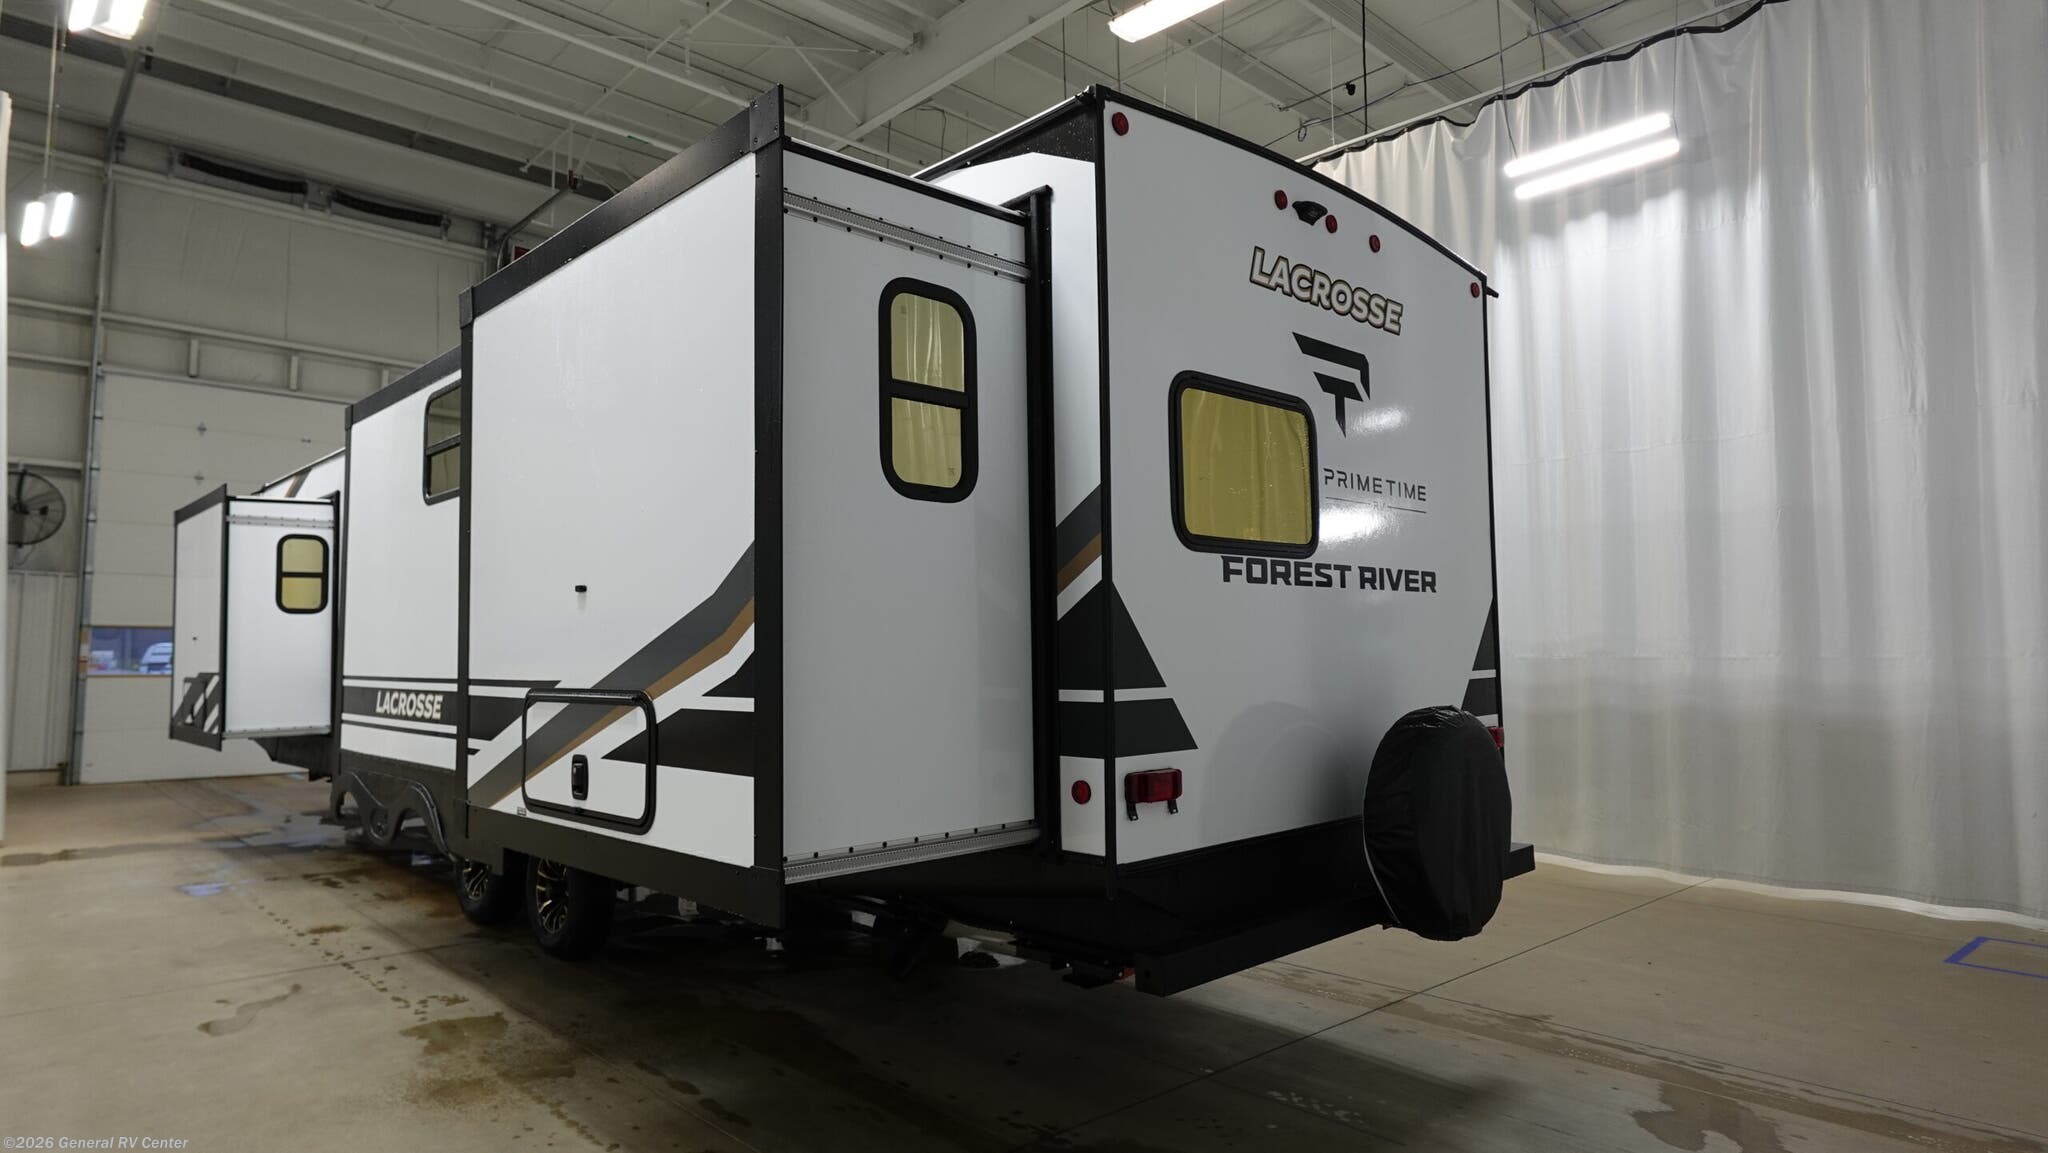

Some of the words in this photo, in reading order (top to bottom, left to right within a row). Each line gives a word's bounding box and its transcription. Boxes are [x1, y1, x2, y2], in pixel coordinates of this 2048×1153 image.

[1250, 246, 1403, 335] LACROSSE
[1220, 555, 1352, 589] FOREST
[1358, 566, 1437, 593] RIVER
[376, 691, 442, 720] LACROSSE
